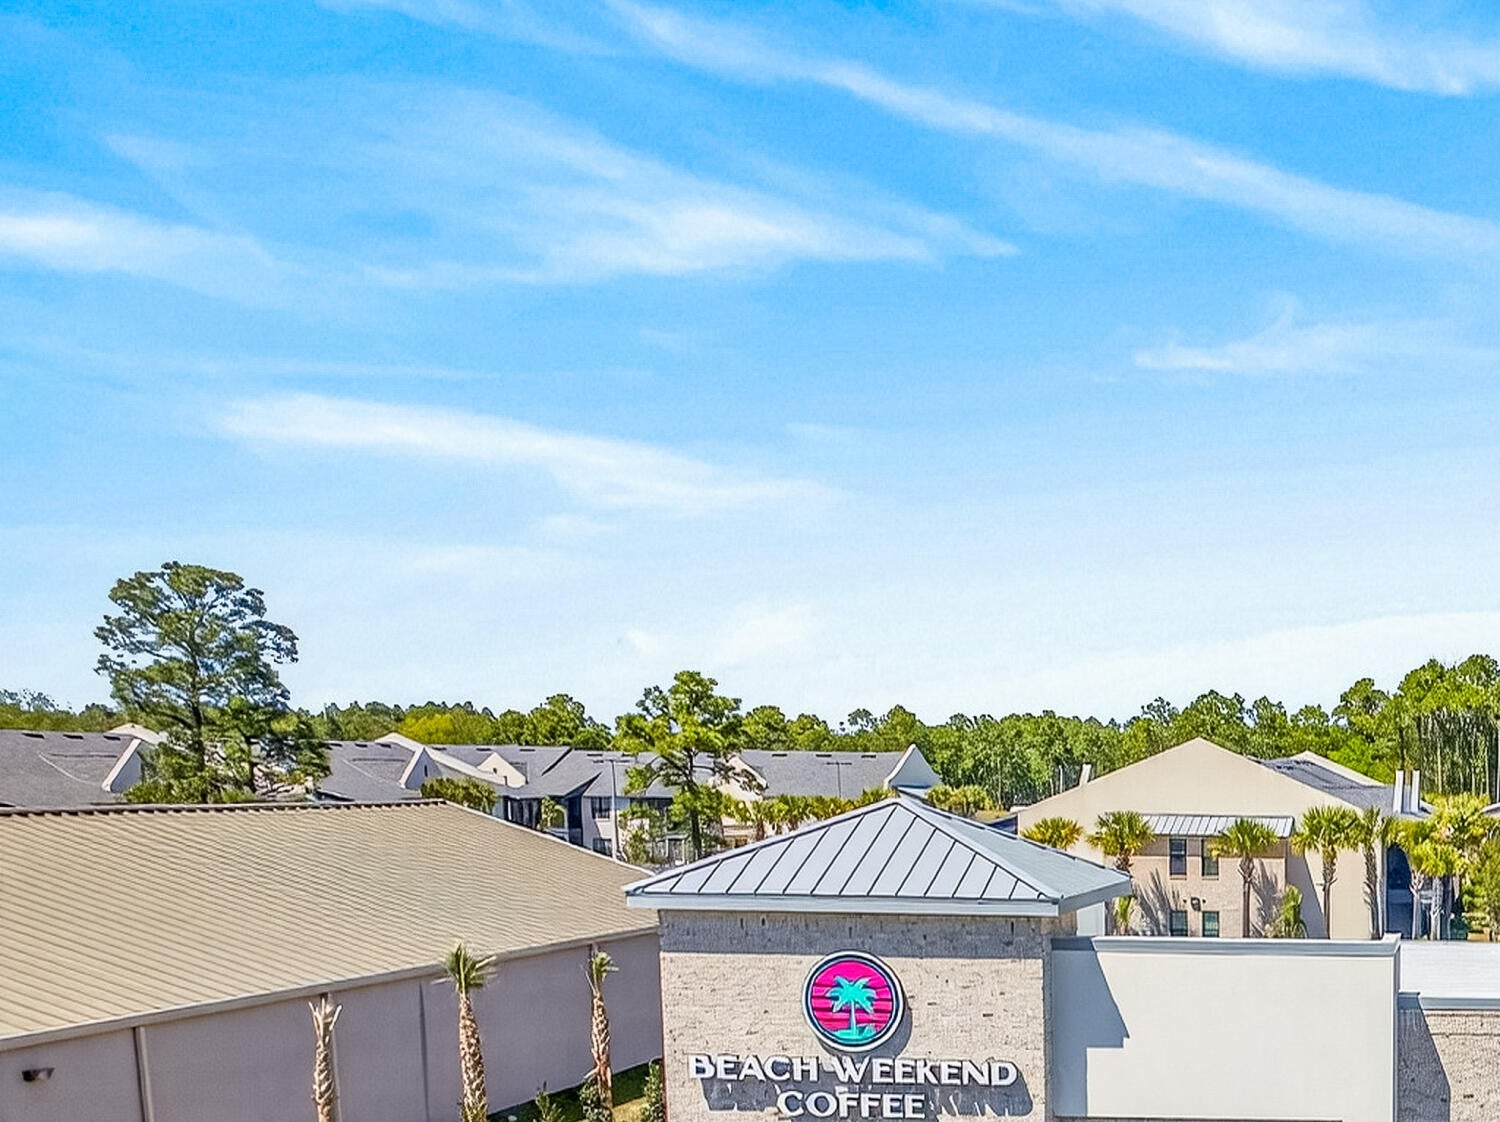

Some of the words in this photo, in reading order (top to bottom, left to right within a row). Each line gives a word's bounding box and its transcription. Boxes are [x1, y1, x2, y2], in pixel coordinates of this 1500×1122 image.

[689, 1054, 820, 1082] BEACH
[834, 1055, 1018, 1086] WEEKEND
[777, 1090, 926, 1118] COFFEE
